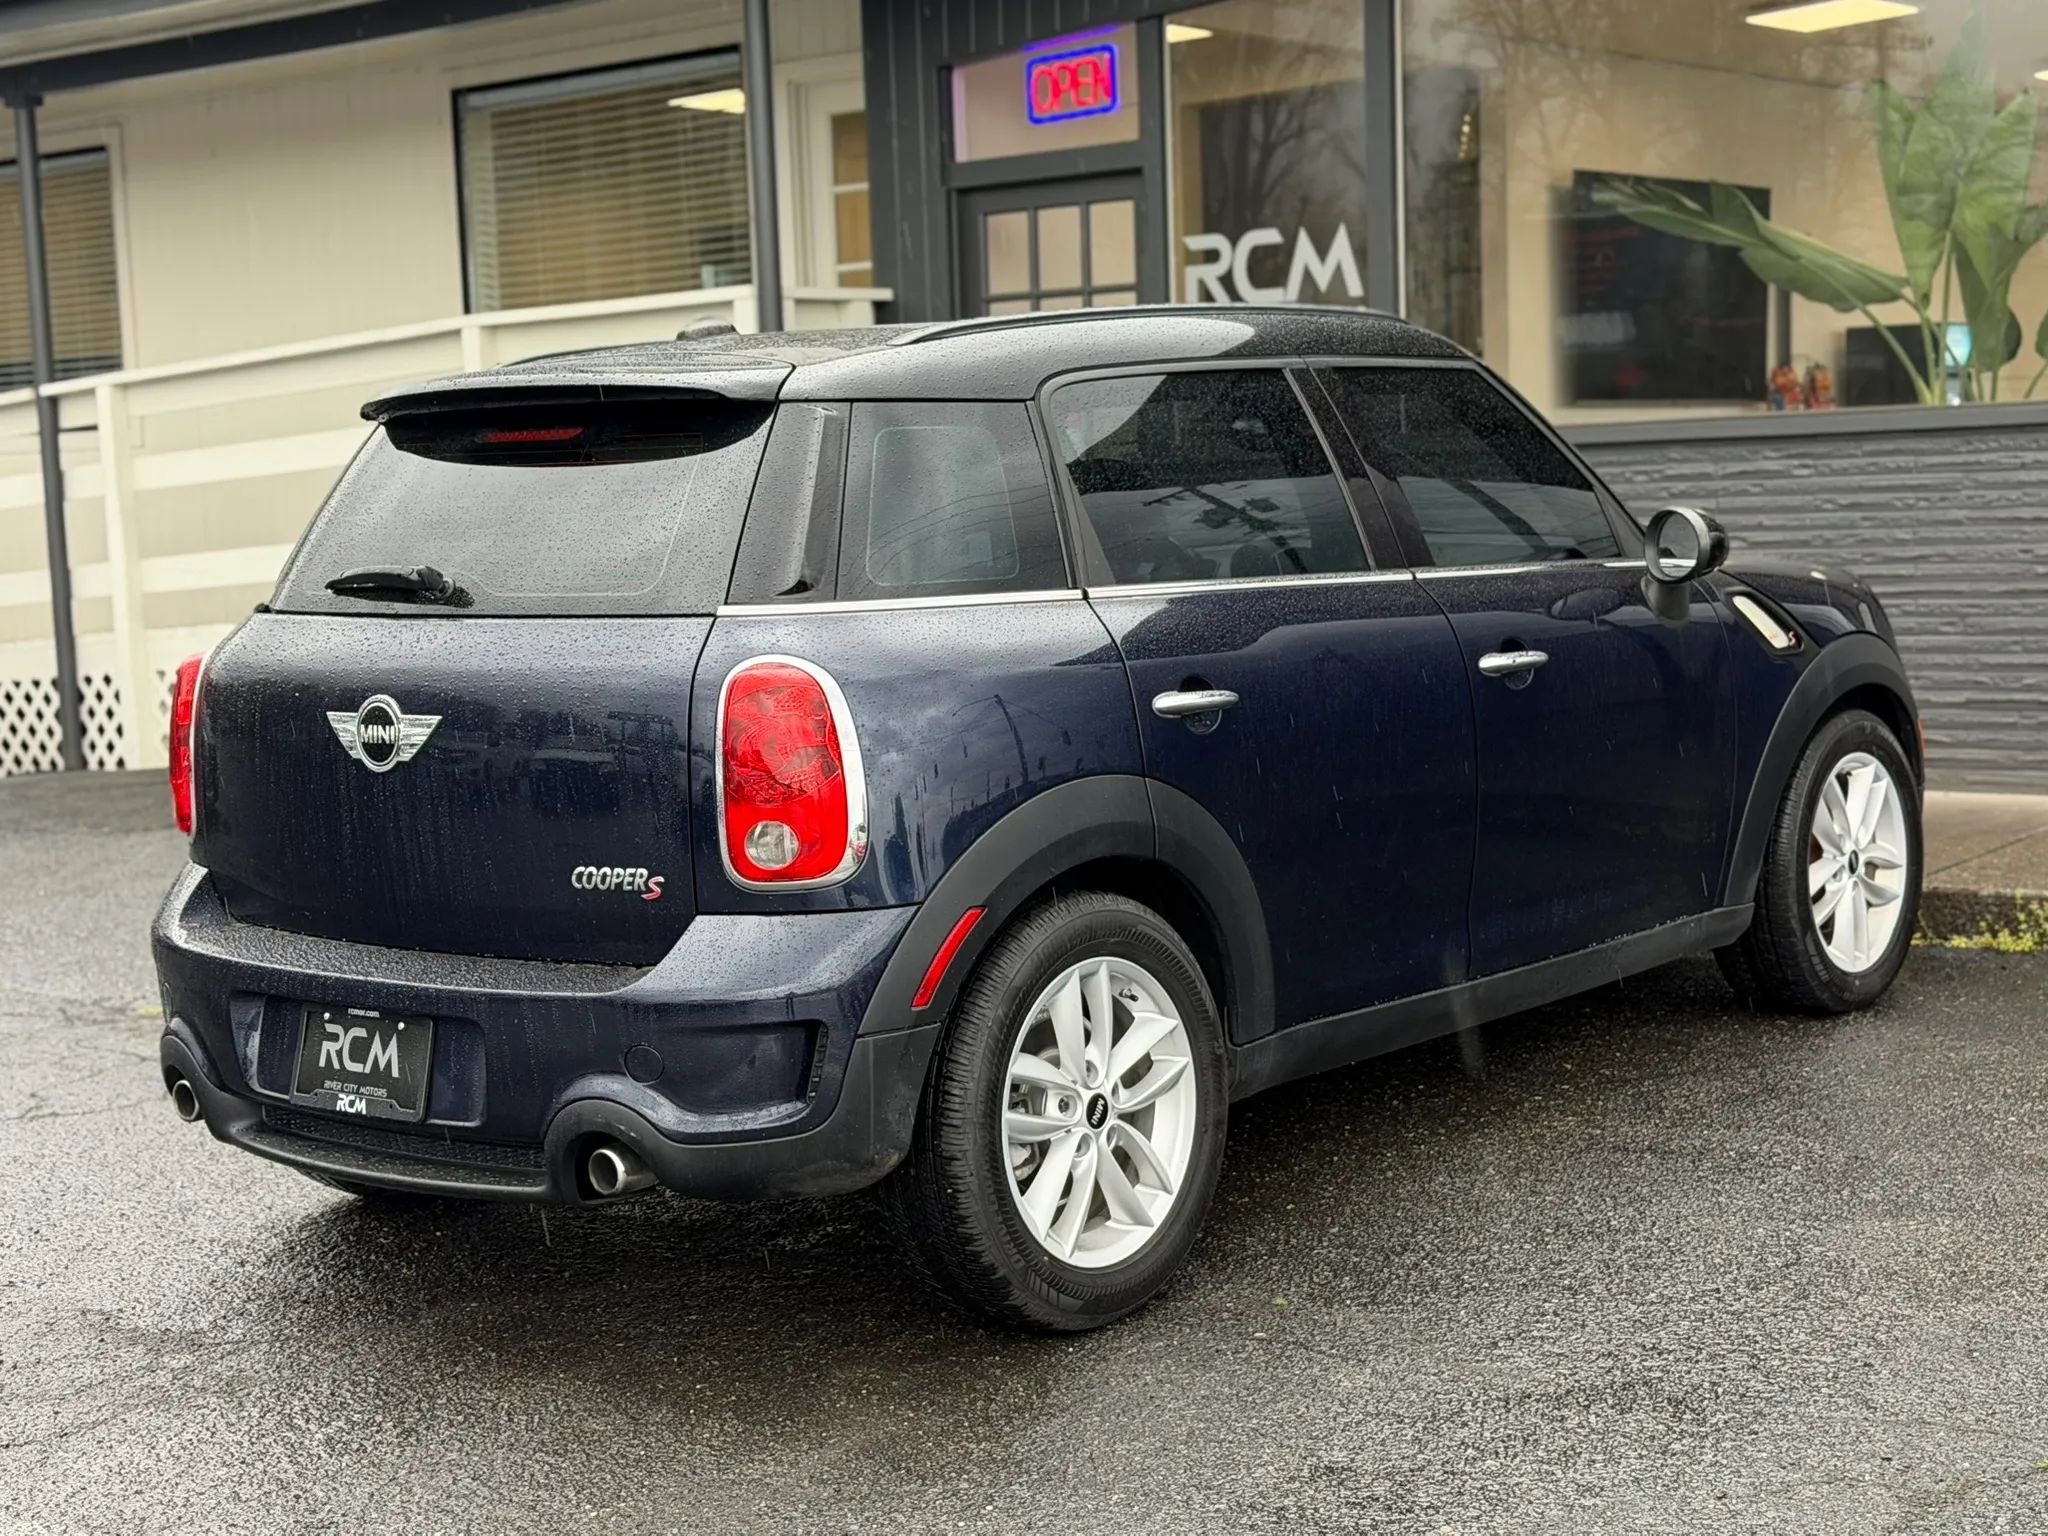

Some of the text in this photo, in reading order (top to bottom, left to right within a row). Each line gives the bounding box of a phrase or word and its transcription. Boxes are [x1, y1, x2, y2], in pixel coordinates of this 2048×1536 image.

[1032, 54, 1111, 115] OPEN
[1183, 222, 1364, 304] RCM
[360, 724, 395, 745] MINI
[571, 866, 665, 900] COOPER S
[318, 1022, 400, 1078] RCM
[323, 1080, 388, 1098] RIVER CITY MOTORS
[336, 1093, 367, 1115] RCM
[1090, 1097, 1105, 1125] MINI
